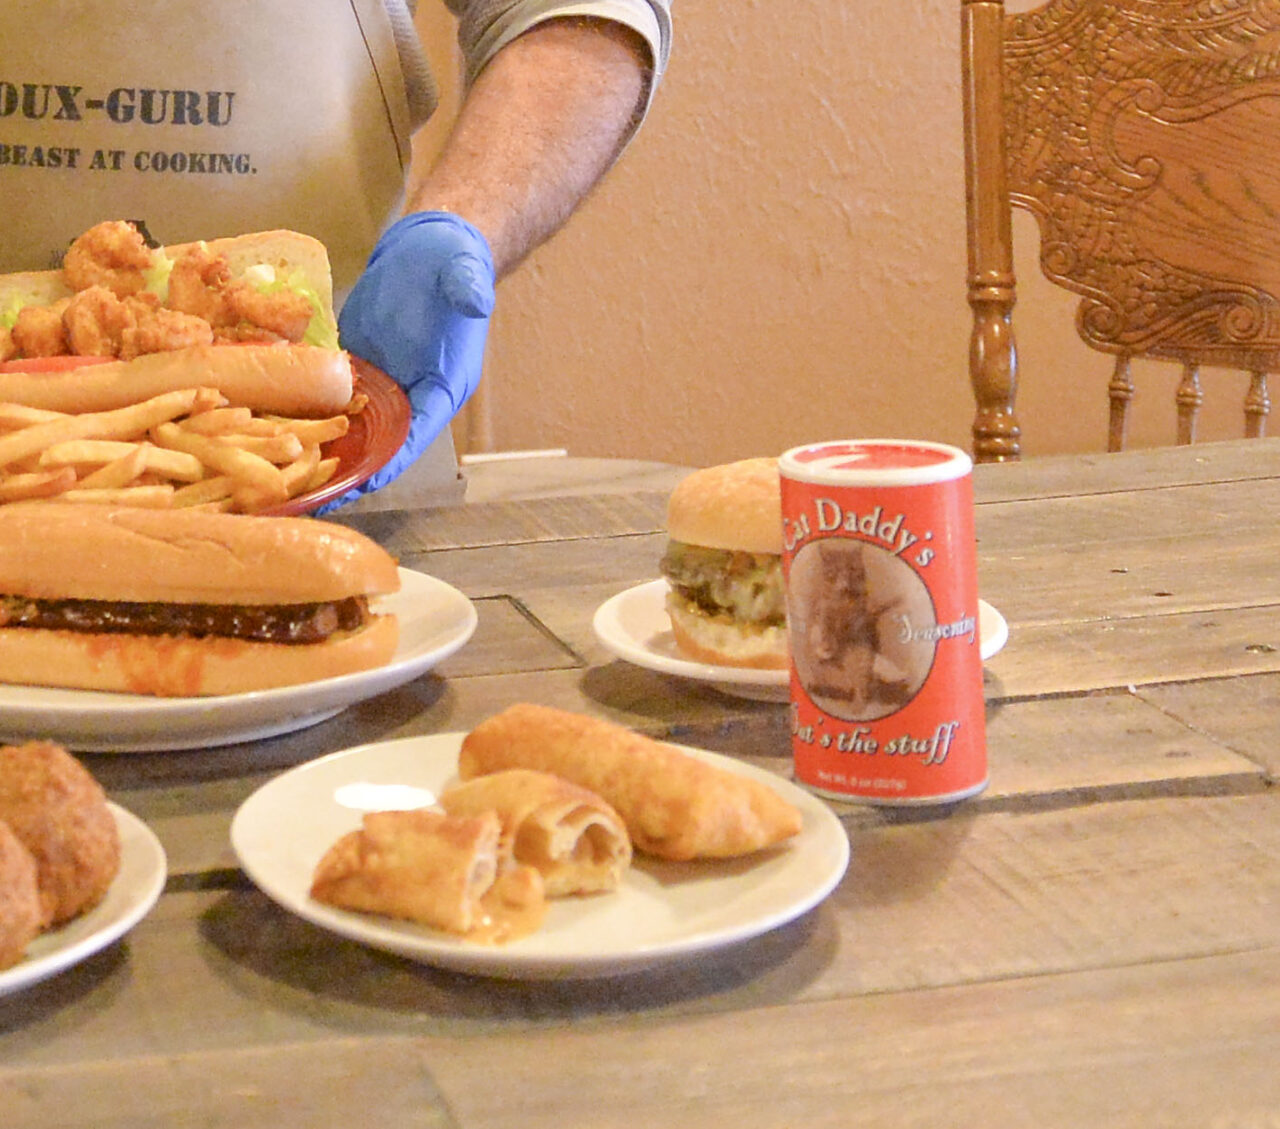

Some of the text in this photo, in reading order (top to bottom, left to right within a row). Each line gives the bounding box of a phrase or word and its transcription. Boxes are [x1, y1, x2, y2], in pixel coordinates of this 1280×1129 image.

[88, 149, 126, 171] AT
[134, 150, 258, 175] COOKING.
[815, 497, 935, 567] Daddy's
[837, 726, 880, 755] the
[883, 720, 961, 765] stuff
